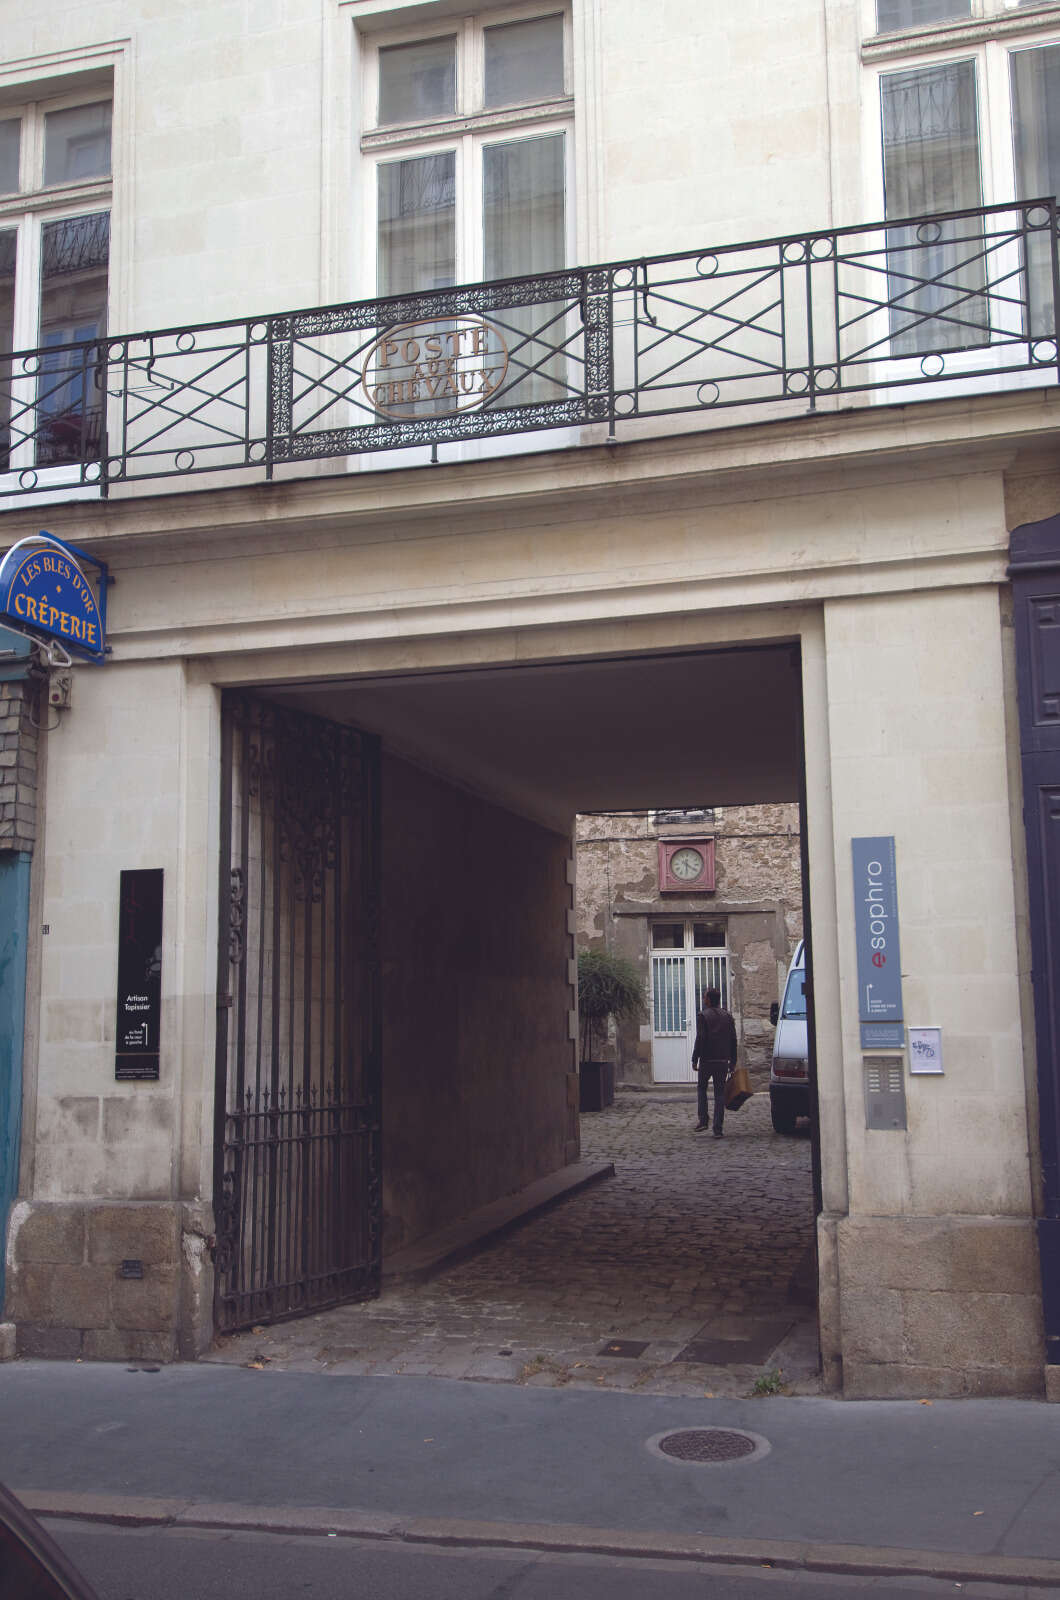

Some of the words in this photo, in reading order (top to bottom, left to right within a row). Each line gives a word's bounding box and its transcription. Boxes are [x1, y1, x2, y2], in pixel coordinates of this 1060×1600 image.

[379, 326, 489, 368] POSTE
[373, 368, 497, 407] CHEVAUX
[413, 358, 457, 379] AUX
[21, 560, 41, 587] LES
[43, 557, 71, 579] BLES
[72, 574, 94, 615] D'OR
[15, 593, 97, 644] CRÊPERIE
[124, 1003, 151, 1012] Tapissier
[126, 994, 148, 1002] Artisan
